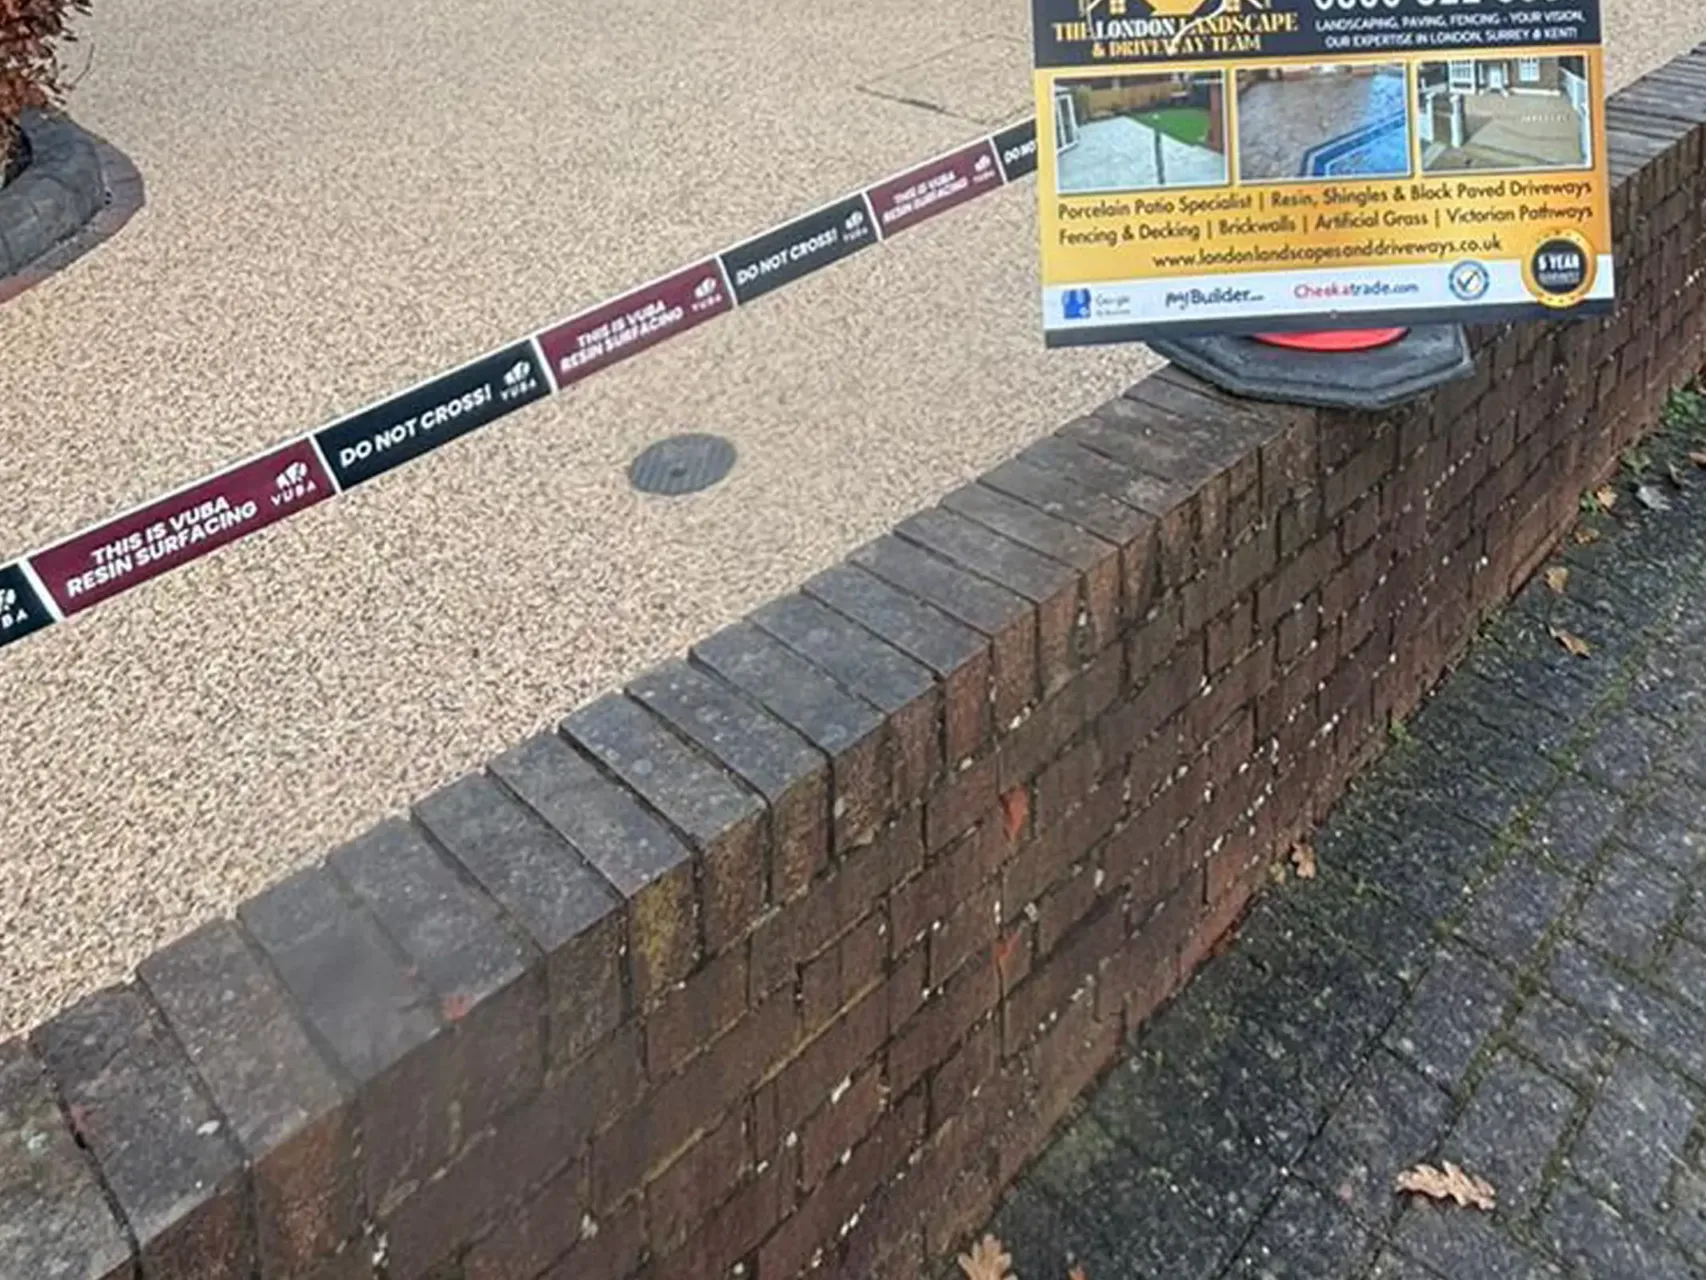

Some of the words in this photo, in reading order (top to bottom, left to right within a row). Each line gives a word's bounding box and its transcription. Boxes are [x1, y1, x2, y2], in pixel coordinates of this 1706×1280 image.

[1052, 22, 1091, 42] THE
[1094, 17, 1175, 39] LONDON
[1175, 12, 1299, 36] LANDSCAPE
[1450, 13, 1499, 26] FENCING
[1509, 11, 1543, 24] YOUR
[1091, 41, 1106, 58] &
[1109, 36, 1209, 58] DRIVEWAY
[1212, 34, 1261, 53] TEAM
[1324, 35, 1351, 48] OUR
[1353, 32, 1414, 47] EXPERTISE
[1485, 28, 1529, 42] SURREY
[1020, 140, 1036, 156] NO
[1058, 200, 1130, 220] Porcelain
[1134, 199, 1175, 216] Patio
[1178, 194, 1252, 217] Specialist
[1271, 190, 1319, 208] Resin,
[1322, 185, 1388, 207] Shingles
[1392, 185, 1405, 201] &
[1410, 183, 1451, 201] Block
[1457, 181, 1505, 199] Paved
[1509, 179, 1592, 201] Driveways
[1059, 227, 1118, 247] Fencing
[1121, 225, 1135, 241] &
[1139, 221, 1200, 241] Decking
[1219, 216, 1296, 235] Brickwalls
[1315, 212, 1380, 230] Artificial
[1383, 210, 1429, 228] Grass
[1447, 206, 1515, 223] Victorian
[1519, 203, 1594, 224] Pathways
[735, 263, 758, 286] DO
[759, 249, 788, 275] NOT
[790, 227, 838, 261] CROSS!
[1152, 234, 1502, 267] www.londonlandscapesanddriveways.co.uk
[1549, 253, 1580, 271] YEAR
[559, 344, 603, 373] RESIN
[605, 305, 684, 352] SURFACING
[577, 324, 610, 348] THIS
[611, 316, 627, 334] IS
[627, 299, 667, 324] VUBA
[499, 378, 537, 402] VUBA
[339, 440, 373, 468] DO
[374, 417, 418, 452] NOT
[420, 383, 492, 430] CROSS!
[270, 481, 318, 507] VUBA
[90, 532, 143, 566] THIS
[144, 521, 167, 545] IS
[169, 495, 232, 532] VUBA
[65, 559, 133, 599] RESIN
[135, 501, 258, 567] SURFACING
[0, 608, 28, 630] BA
